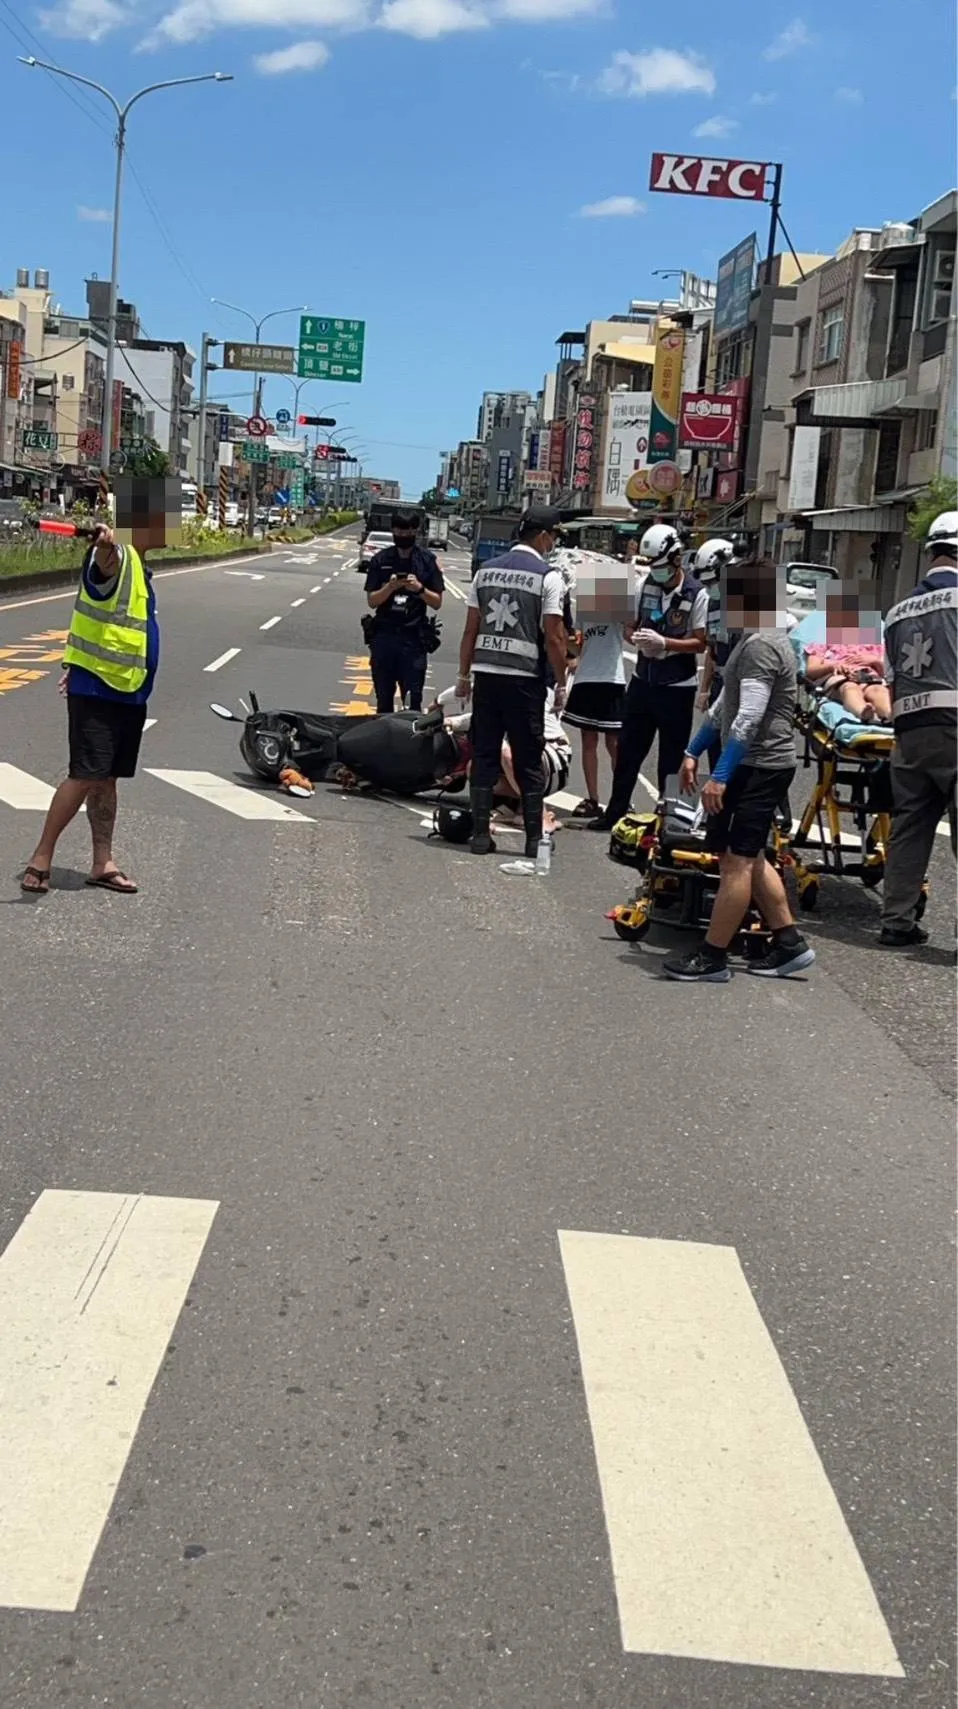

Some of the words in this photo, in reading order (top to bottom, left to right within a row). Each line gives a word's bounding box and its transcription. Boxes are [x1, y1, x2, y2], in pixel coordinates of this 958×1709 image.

[654, 156, 761, 197] KFC
[481, 636, 513, 650] EMT
[903, 694, 931, 711] EMT
